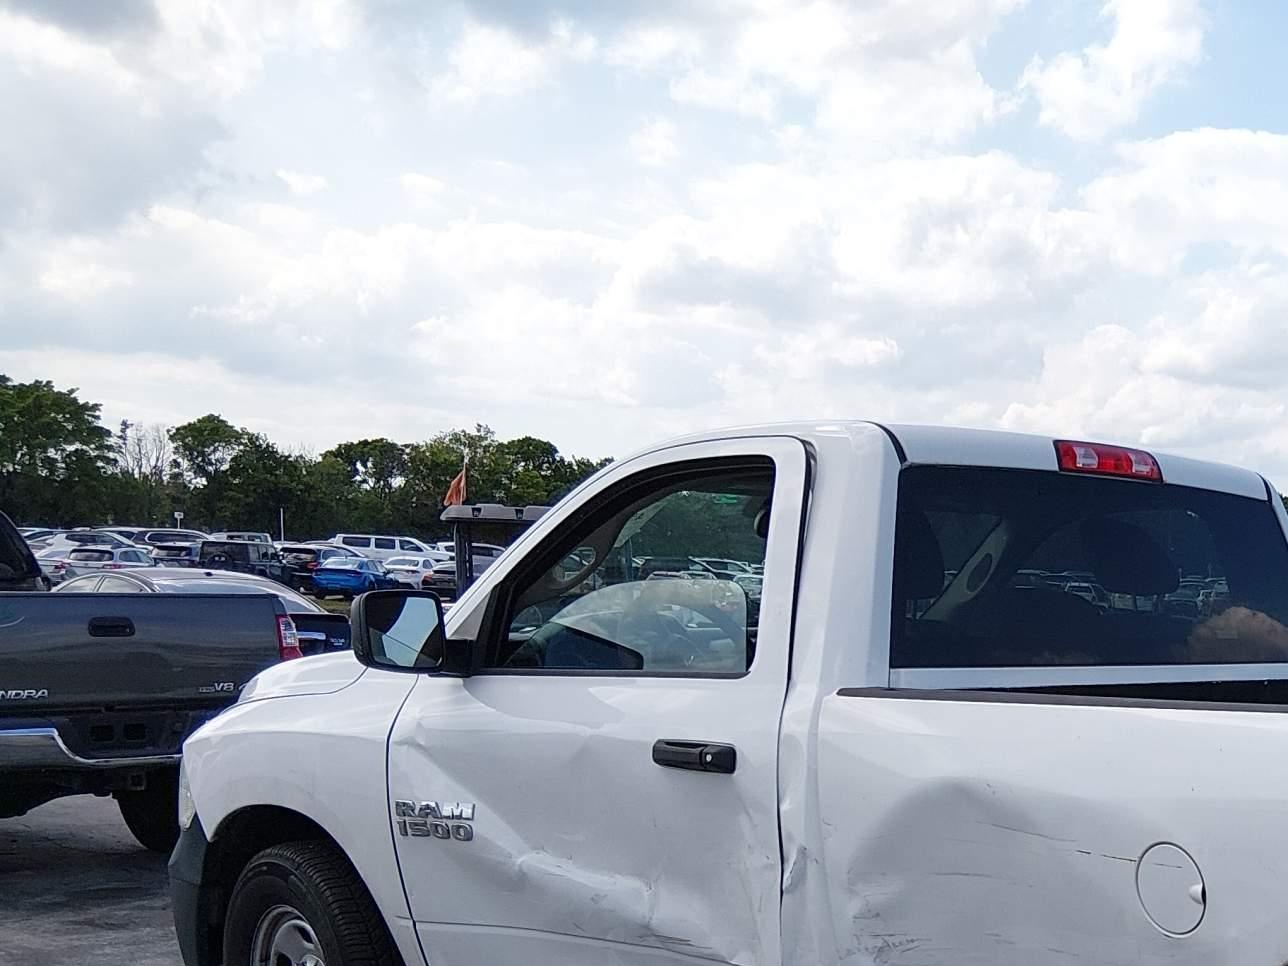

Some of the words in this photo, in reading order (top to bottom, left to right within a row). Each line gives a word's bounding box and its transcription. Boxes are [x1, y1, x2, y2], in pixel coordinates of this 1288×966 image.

[214, 682, 234, 692] V8
[394, 799, 476, 821] RAM
[396, 819, 474, 842] 1500
